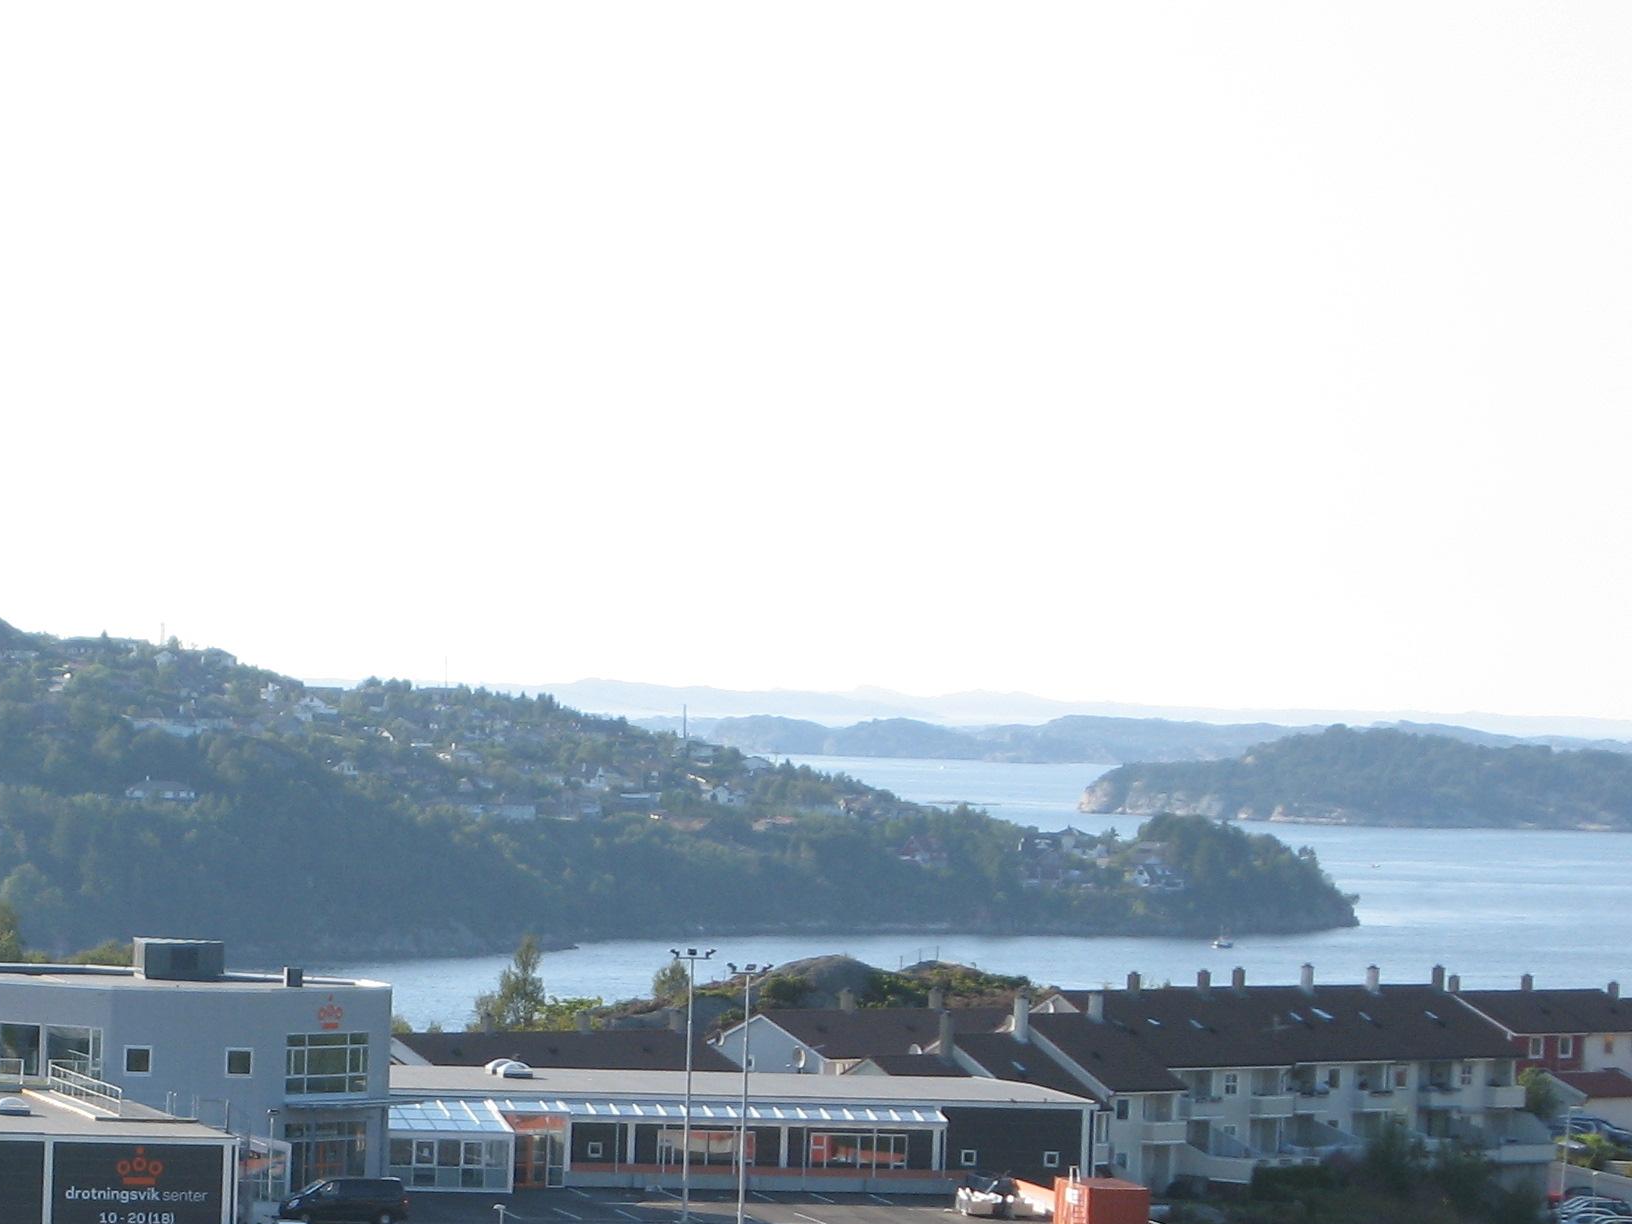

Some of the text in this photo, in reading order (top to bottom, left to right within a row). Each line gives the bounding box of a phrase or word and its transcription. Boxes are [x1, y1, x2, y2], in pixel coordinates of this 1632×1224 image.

[65, 1185, 208, 1203] drotningsvik senter
[99, 1212, 117, 1224] 10
[127, 1212, 146, 1224] 20
[148, 1212, 175, 1224] (18)
